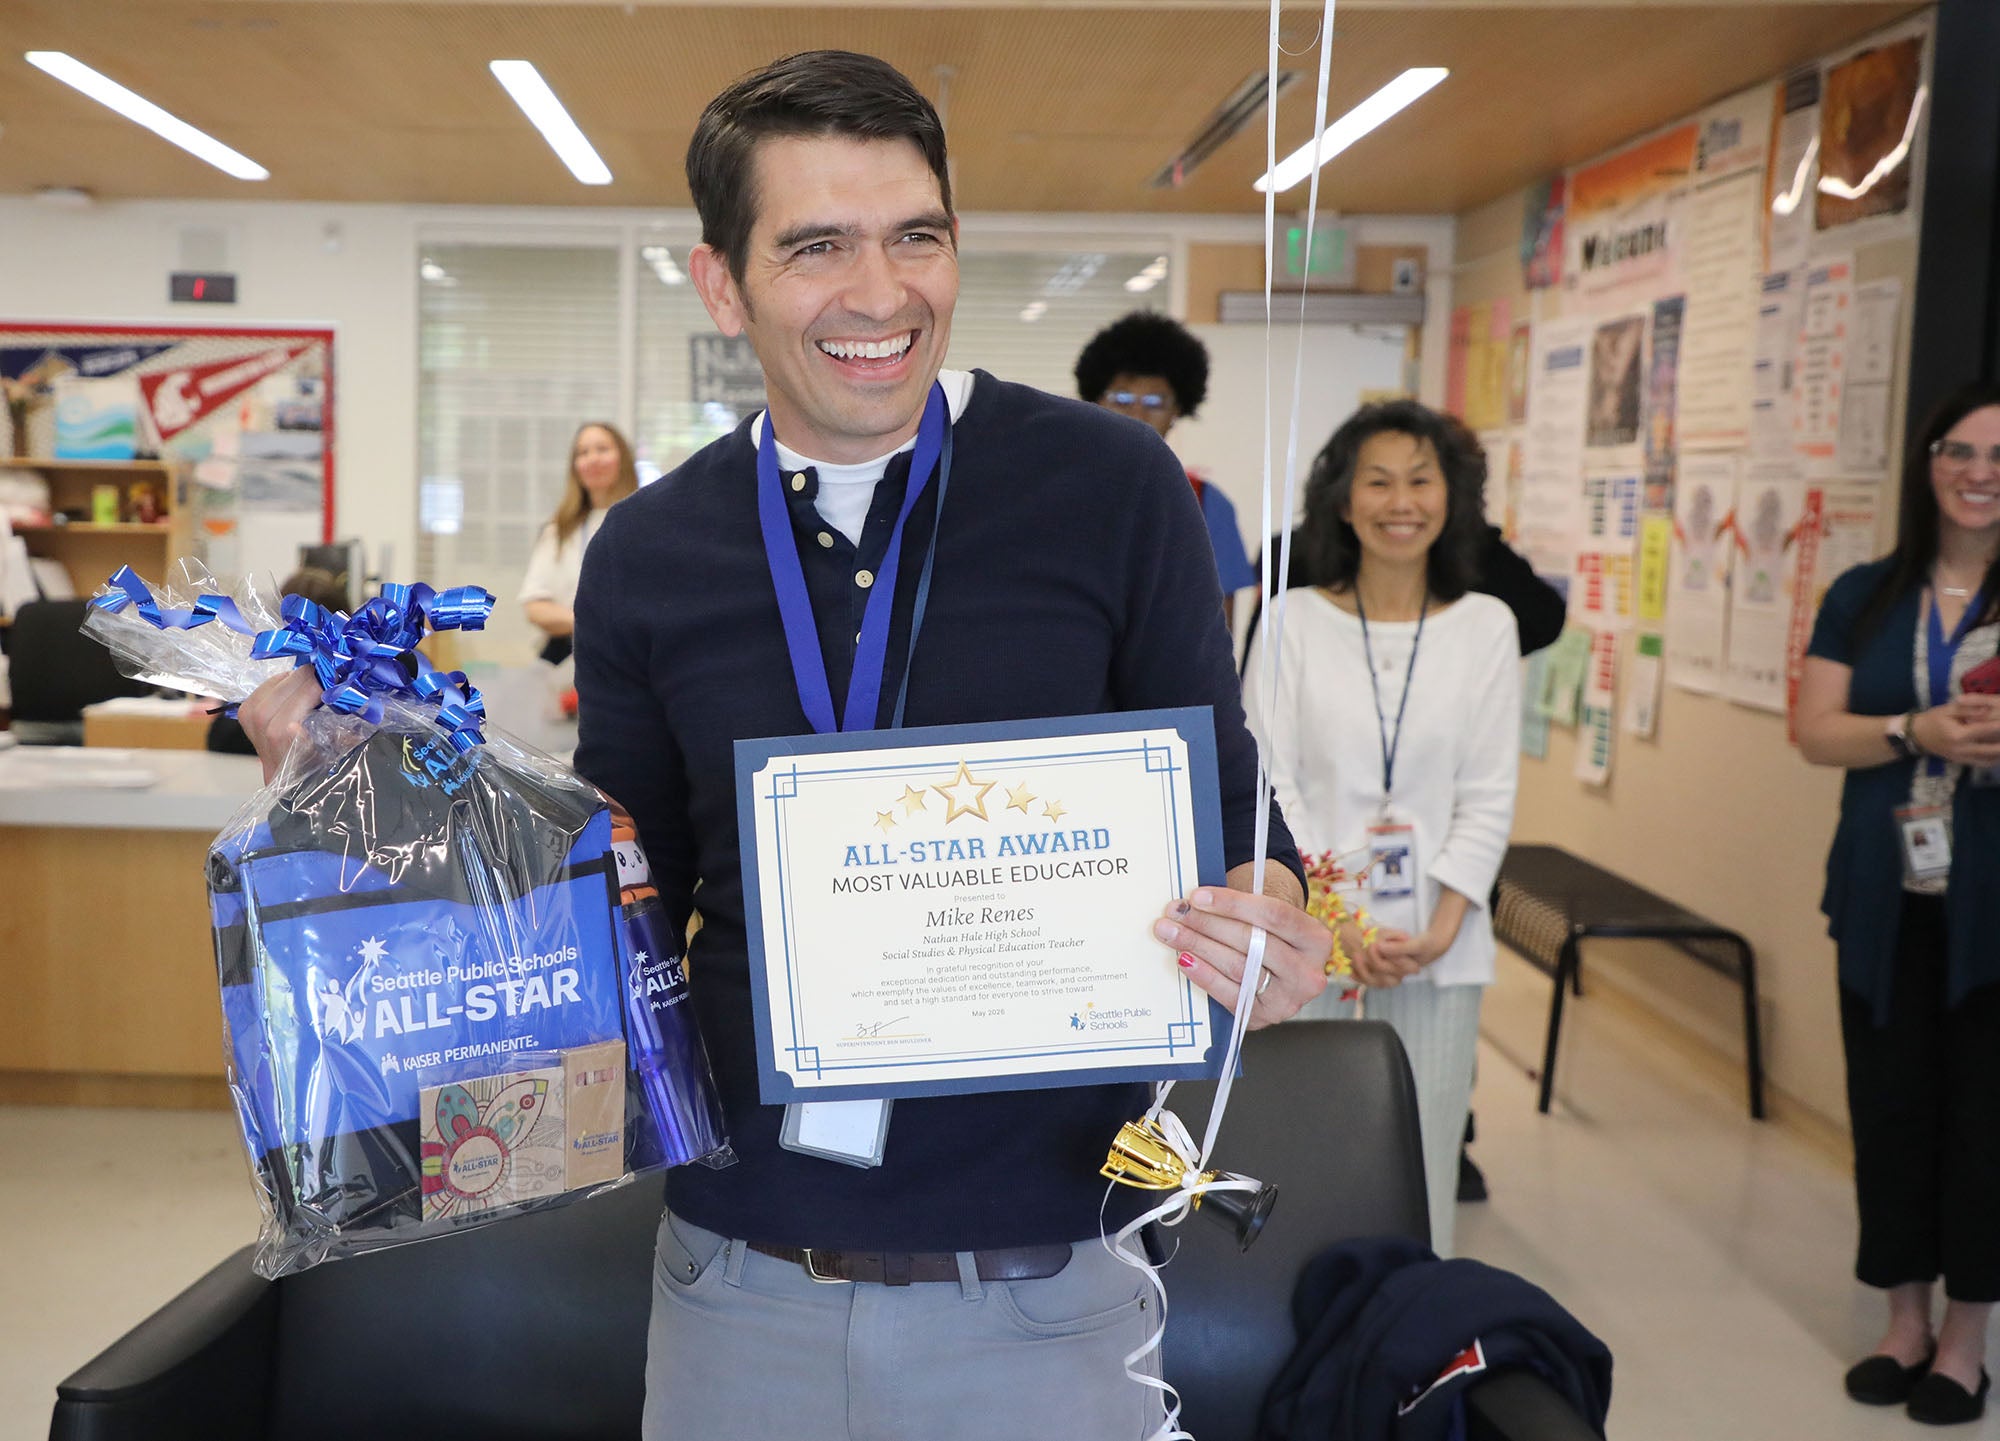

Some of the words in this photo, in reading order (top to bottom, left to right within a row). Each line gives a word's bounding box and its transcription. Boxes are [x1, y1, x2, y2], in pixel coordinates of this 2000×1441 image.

[843, 838, 987, 867] ALL-STAR
[998, 828, 1110, 857] AWARD
[832, 874, 894, 894] MOST
[899, 868, 1003, 890] VALUABLE
[1010, 858, 1129, 883] EDUCATOR
[953, 894, 995, 903] Presented
[997, 892, 1006, 900] to
[925, 907, 975, 928] Mike
[979, 907, 1035, 924] Renes
[922, 934, 958, 945] Nathan
[961, 932, 983, 942] Hale
[985, 929, 1008, 942] High
[1010, 927, 1041, 939] School
[882, 949, 910, 961] Social
[912, 948, 945, 959] Studies
[947, 946, 956, 957] &
[958, 944, 996, 958] Physical
[998, 941, 1046, 953] Education
[1048, 938, 1086, 949] Teacher
[371, 968, 443, 994] Seattle
[446, 961, 504, 984] Public
[507, 945, 578, 974] Schools
[643, 961, 670, 976] Seattle
[880, 976, 926, 987] exceptional
[928, 974, 970, 984] dedication
[972, 973, 987, 981] and
[989, 969, 1037, 979] outstanding
[1038, 965, 1093, 977] performance,
[926, 966, 935, 974] In
[936, 964, 967, 975] grateful
[968, 962, 1014, 972] recognition
[1015, 960, 1024, 968] of
[1026, 959, 1044, 969] your
[646, 965, 685, 997] ALL-S
[850, 989, 875, 999] which
[876, 986, 914, 997] exemplify
[916, 986, 930, 994] the
[931, 984, 957, 993] values
[958, 983, 967, 992] of
[969, 981, 1014, 991] excellence,
[1016, 977, 1058, 988] teamwork,
[1060, 976, 1075, 984] and
[1077, 972, 1128, 982] commitment
[374, 968, 582, 1039] ALL-STAR
[661, 996, 680, 1009] KAISER
[883, 998, 899, 1007] and
[900, 998, 913, 1006] set
[922, 995, 940, 1006] high
[941, 993, 977, 1003] standard
[978, 992, 989, 1000] for
[991, 990, 1029, 999] everyone
[1041, 987, 1064, 996] strive
[971, 1010, 986, 1018] May
[1088, 1009, 1123, 1020] Seattle
[1123, 1007, 1152, 1018] Public
[1090, 1020, 1128, 1031] Schools
[402, 1047, 441, 1072] KAISER
[582, 1135, 619, 1150] ALL-STAR
[462, 1158, 499, 1173] ALL-STAR
